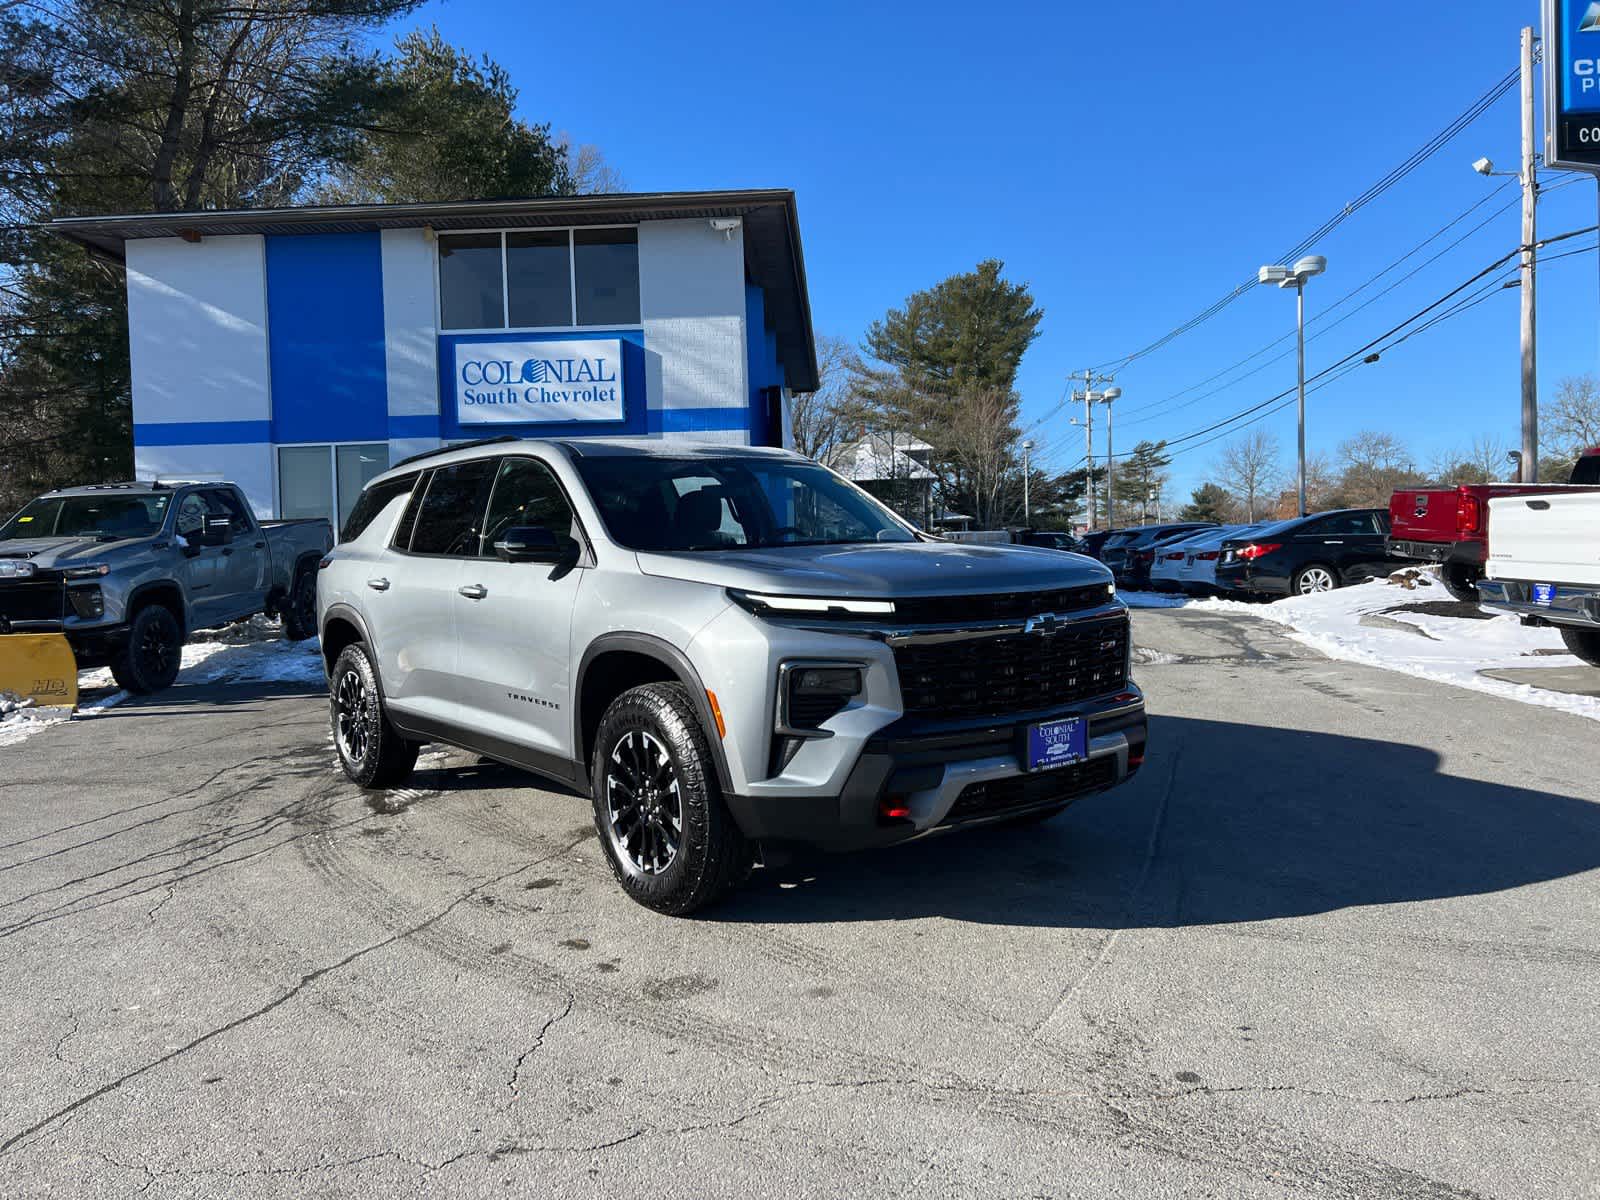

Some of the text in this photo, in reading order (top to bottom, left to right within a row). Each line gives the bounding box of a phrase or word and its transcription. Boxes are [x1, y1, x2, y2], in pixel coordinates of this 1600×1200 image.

[1574, 59, 1600, 76] C
[1582, 78, 1600, 93] P
[462, 358, 616, 386] COLONIAL
[463, 386, 616, 405] South Chevrolet
[507, 692, 561, 711] TRAVERSE
[1039, 723, 1074, 738] COLONIAL
[1045, 733, 1070, 745] SOUTH
